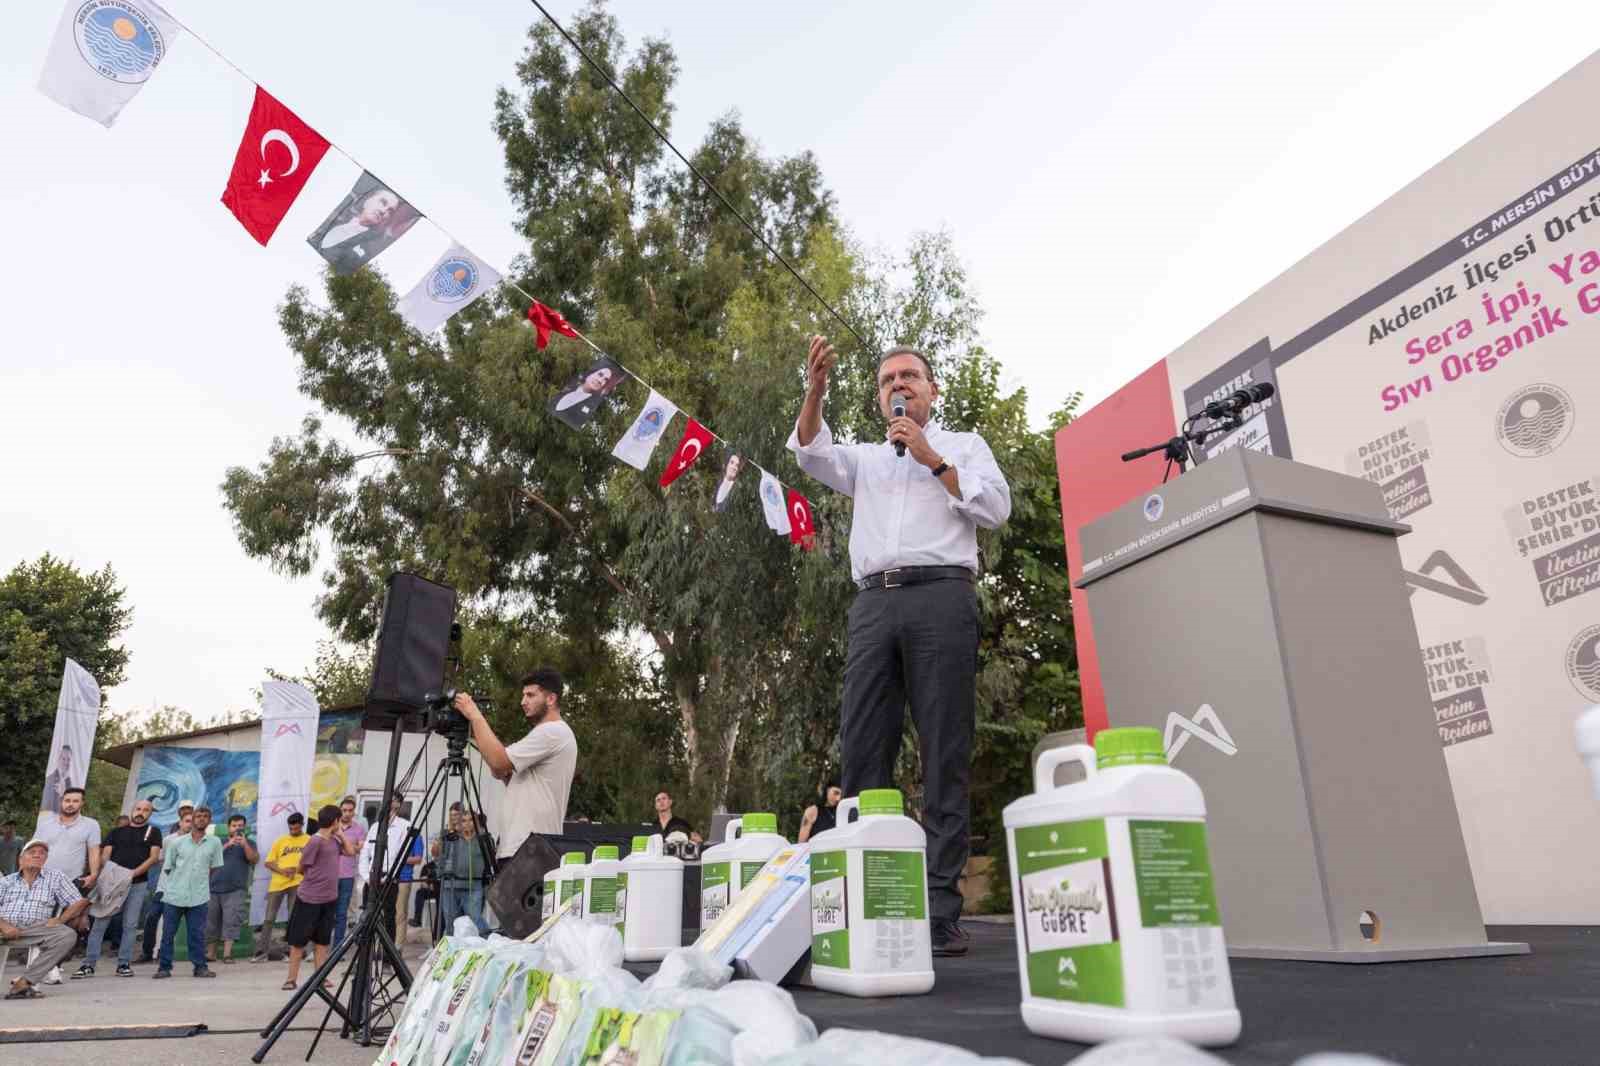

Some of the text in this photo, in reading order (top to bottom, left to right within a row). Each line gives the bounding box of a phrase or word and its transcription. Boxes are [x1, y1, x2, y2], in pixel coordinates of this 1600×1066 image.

[1461, 228, 1489, 248] T.C.
[1491, 184, 1555, 232] MERSİN
[1368, 284, 1457, 345] Akdeniz
[1463, 233, 1536, 291] İlçesi
[1405, 250, 1600, 365] Sera İpi, Ya
[1381, 375, 1433, 411] Sıvı
[1440, 304, 1569, 382] Organik
[1358, 426, 1408, 457] DESTEK
[1522, 480, 1593, 515] DESTEK
[1424, 639, 1465, 661] STEK
